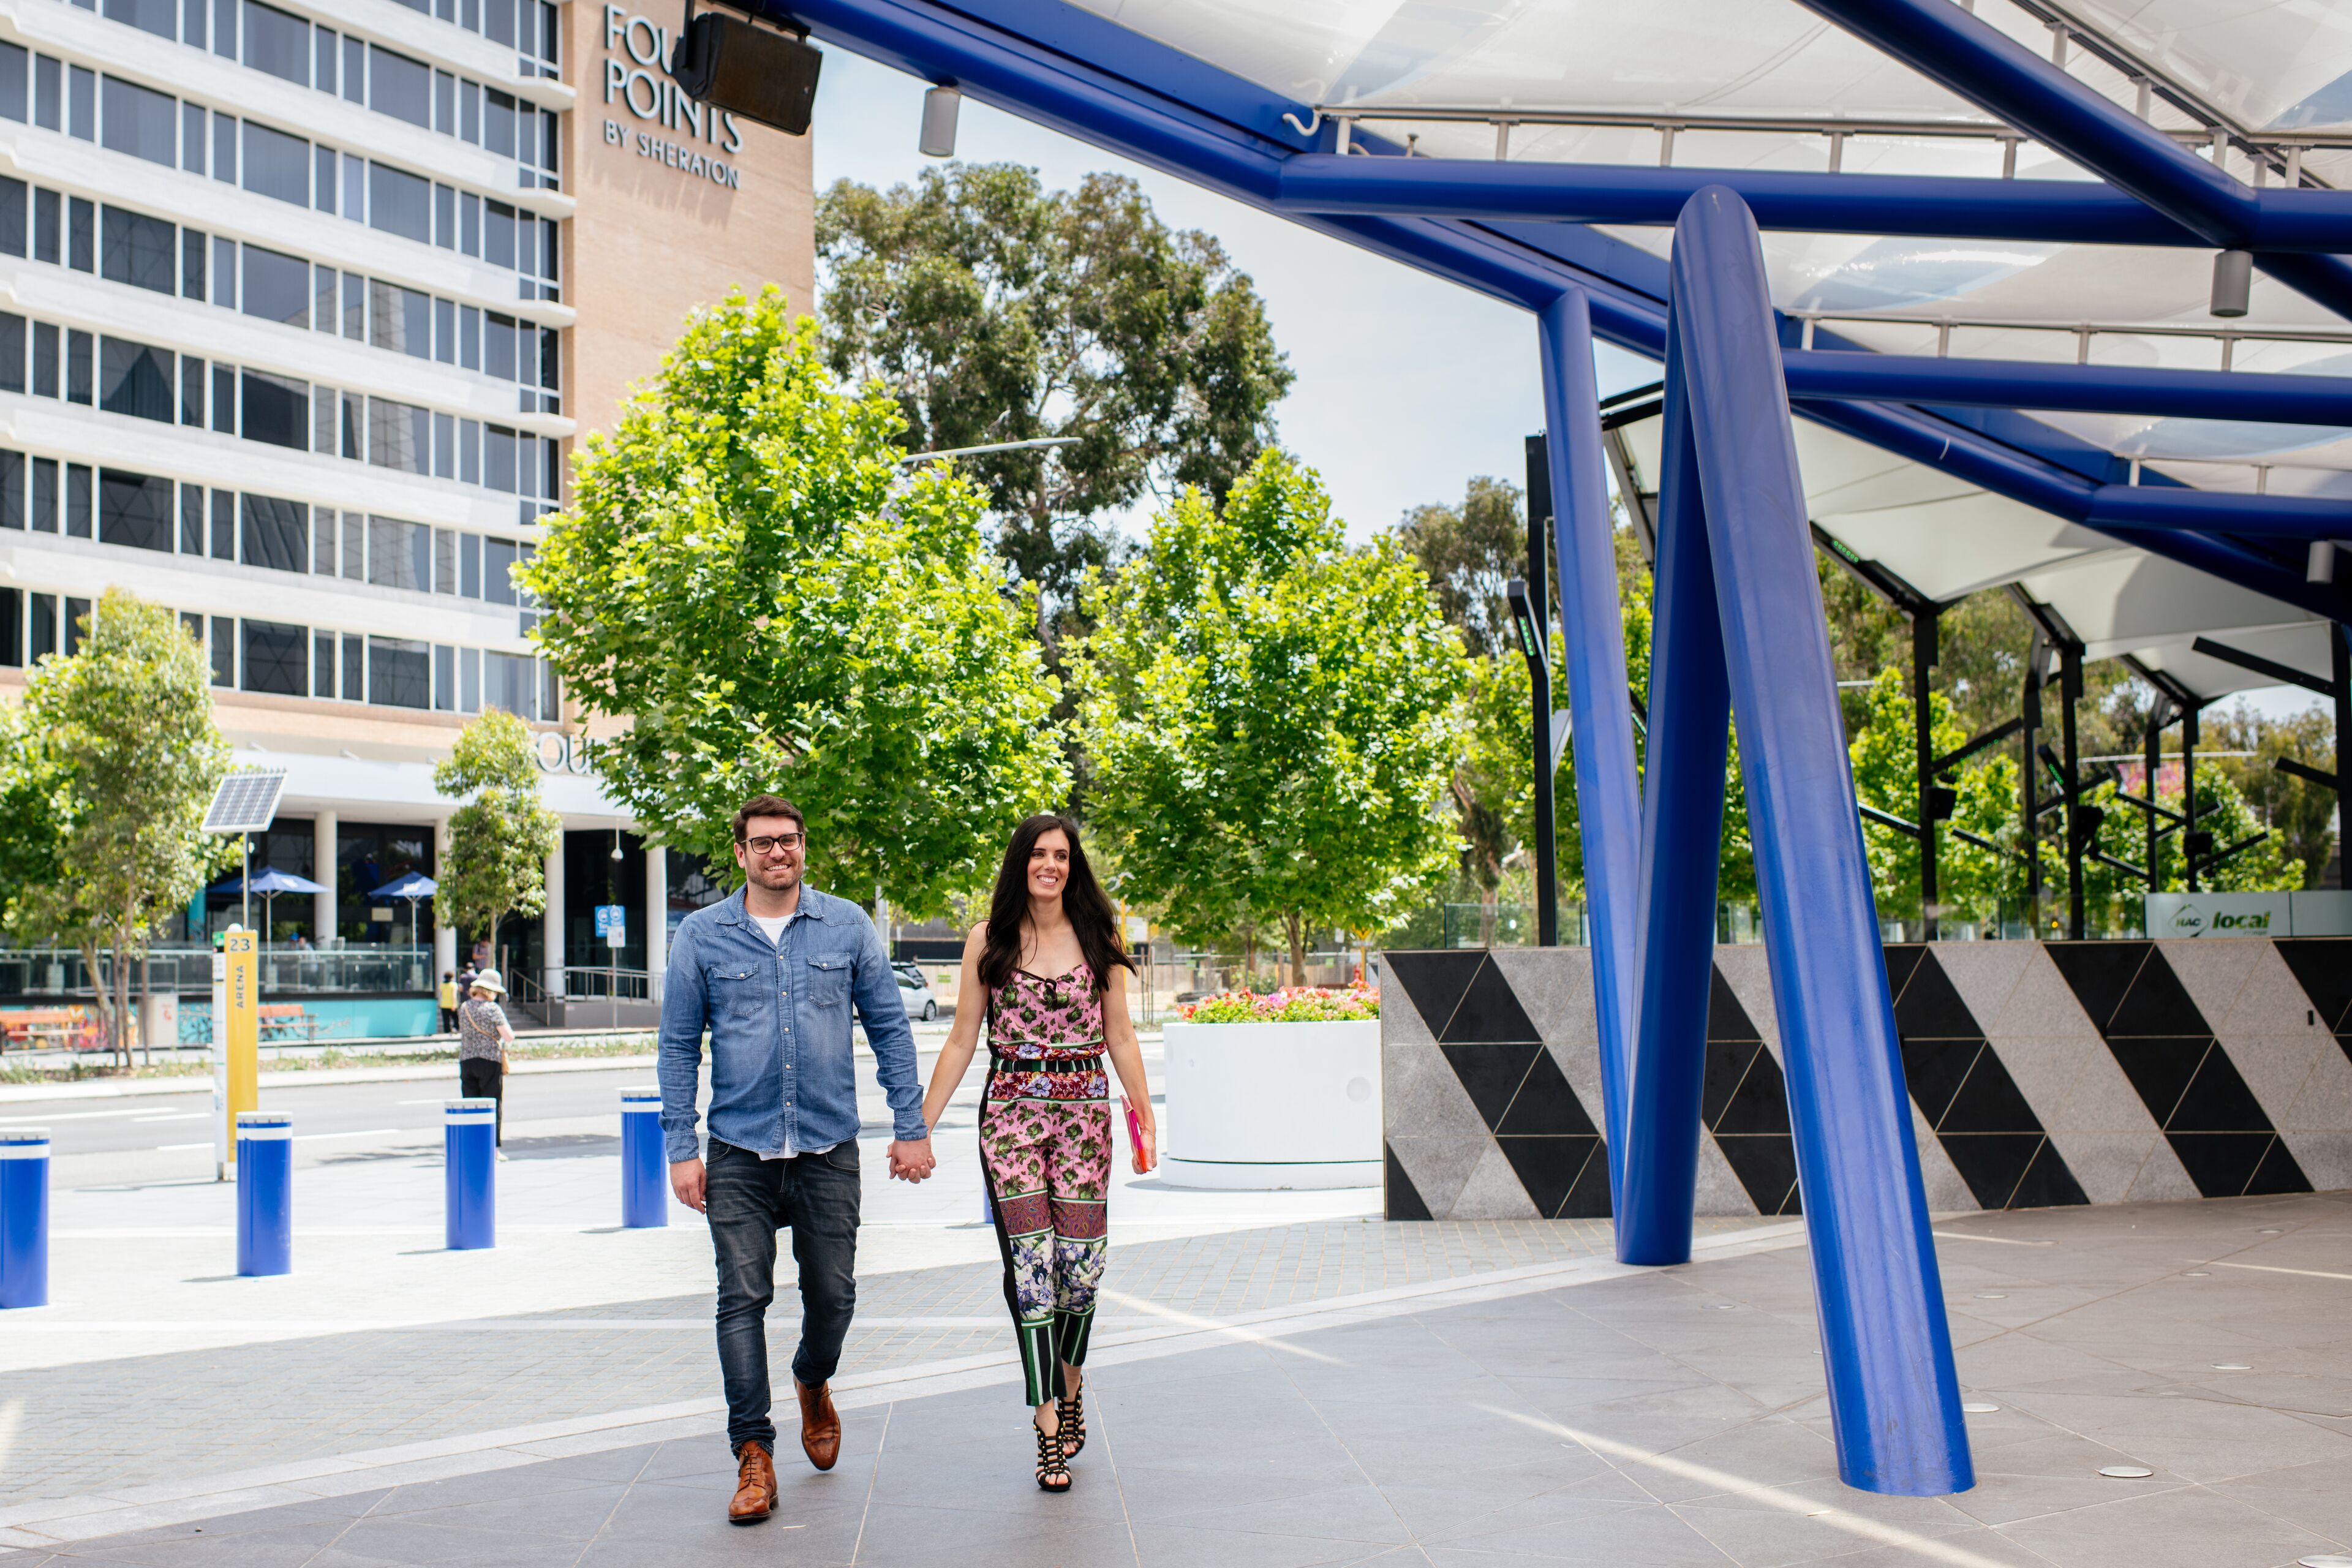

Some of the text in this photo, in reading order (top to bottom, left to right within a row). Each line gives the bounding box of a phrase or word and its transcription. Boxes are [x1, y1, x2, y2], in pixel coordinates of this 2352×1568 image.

[604, 4, 673, 74] FOU
[605, 119, 741, 189] BY SHERATON
[530, 731, 606, 777] OU
[2212, 910, 2271, 929] local
[230, 938, 250, 951] 23
[235, 965, 244, 1009] ARENA
